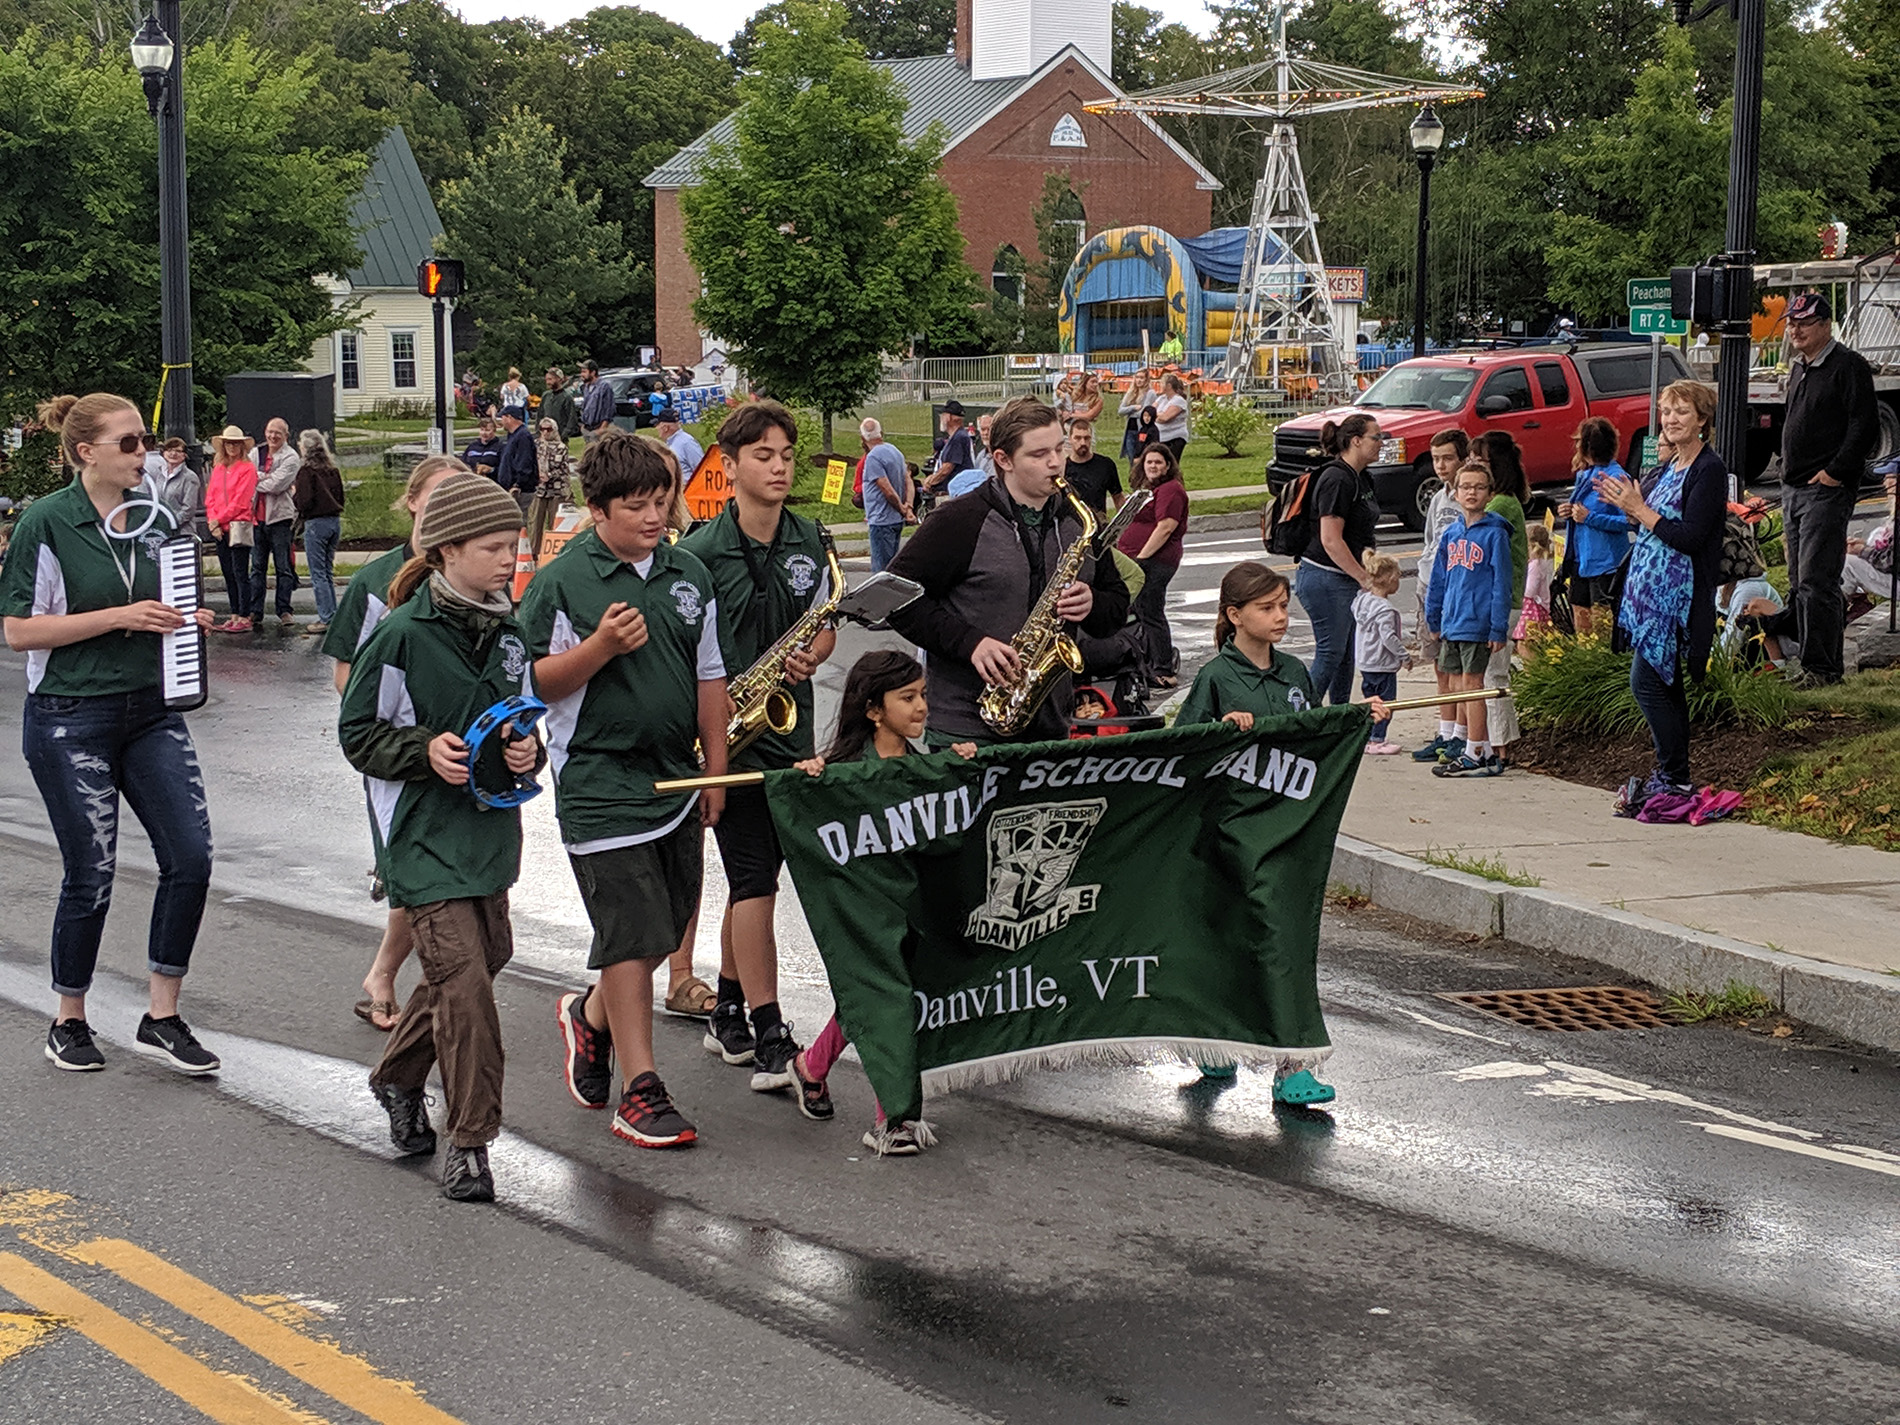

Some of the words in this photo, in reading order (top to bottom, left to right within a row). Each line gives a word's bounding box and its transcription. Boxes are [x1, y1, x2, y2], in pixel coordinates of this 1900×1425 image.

[1327, 276, 1359, 293] KETS
[1632, 286, 1672, 300] Peacham
[1639, 313, 1653, 328] RT
[1658, 313, 1666, 328] 2
[704, 470, 735, 492] ROA
[698, 500, 723, 520] CLO
[1447, 539, 1484, 571] GAP
[816, 765, 1009, 867] DANVILE
[1018, 754, 1188, 792] SCHOOL
[1204, 743, 1318, 801] BAND
[1078, 889, 1094, 912] S
[977, 903, 1071, 950] DANVILLE
[1081, 955, 1160, 1001] VT
